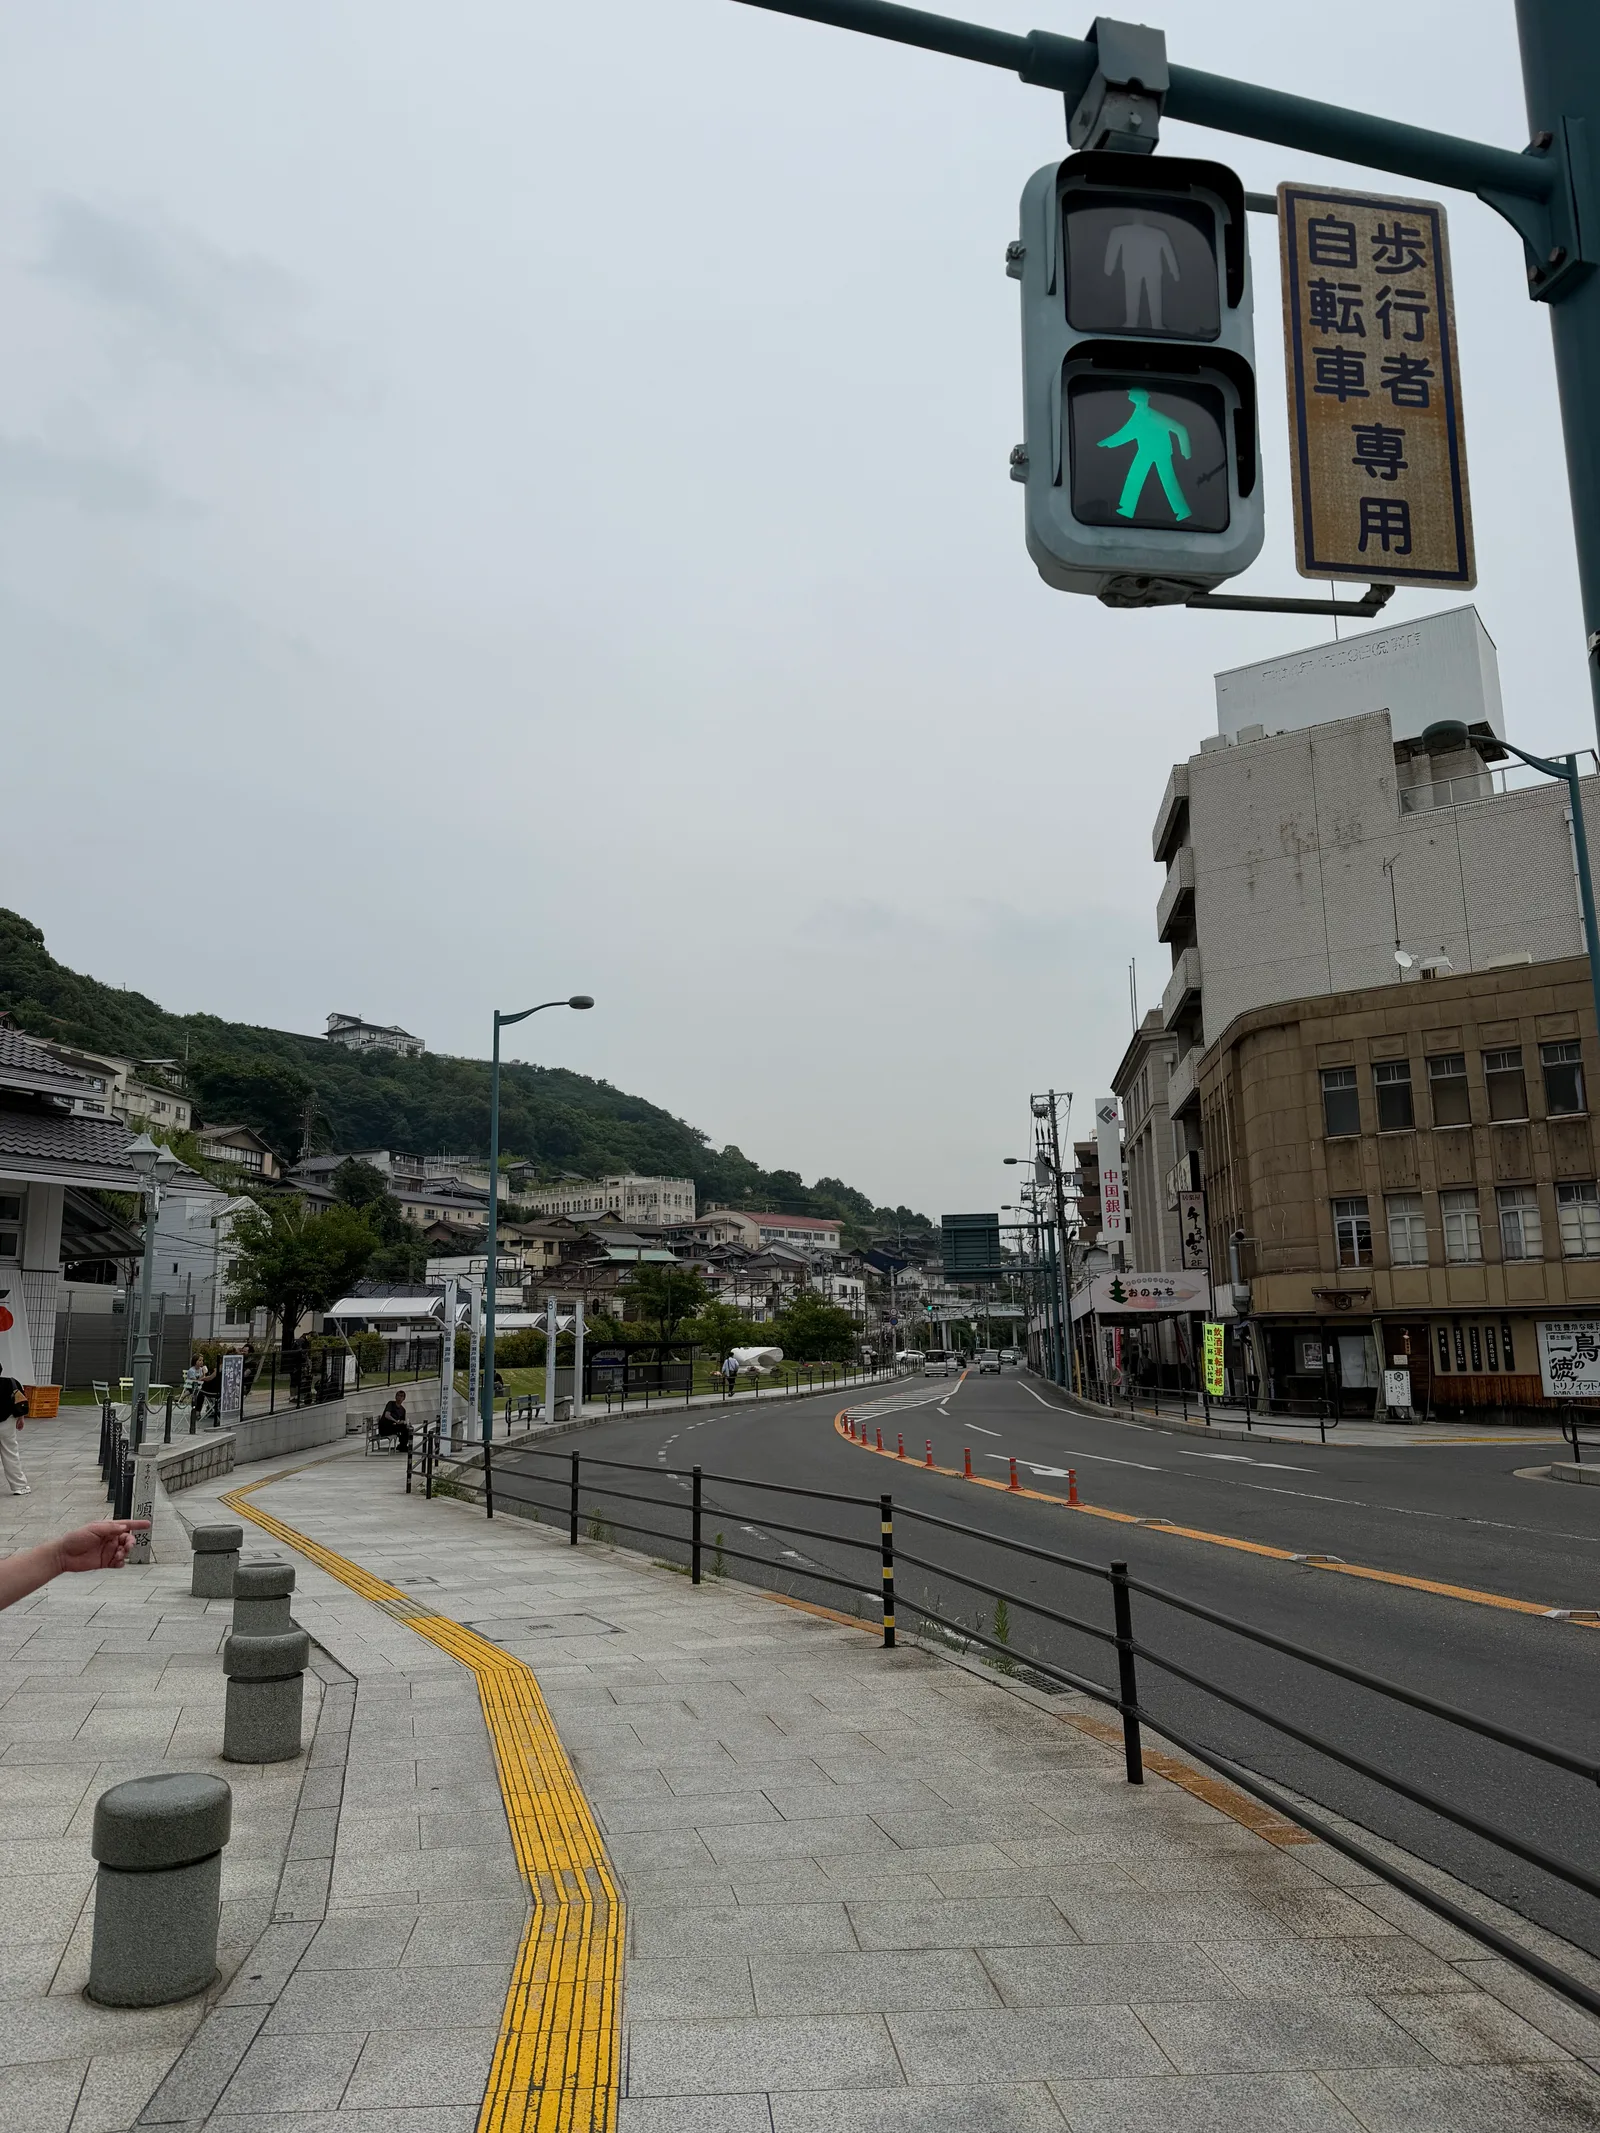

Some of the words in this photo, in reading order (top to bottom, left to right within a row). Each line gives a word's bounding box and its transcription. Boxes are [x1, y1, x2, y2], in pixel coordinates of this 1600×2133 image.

[1307, 213, 1370, 403] 自転車
[1370, 220, 1435, 409] 歩行者
[1351, 422, 1412, 556] 専用
[1104, 1169, 1121, 1229] 中国銀行
[446, 1280, 453, 1292] 7
[548, 1301, 554, 1310] 8
[1128, 1287, 1175, 1298] おのみち
[1213, 1327, 1222, 1387] 飲酒運転根絶
[134, 1501, 153, 1547] 順路
